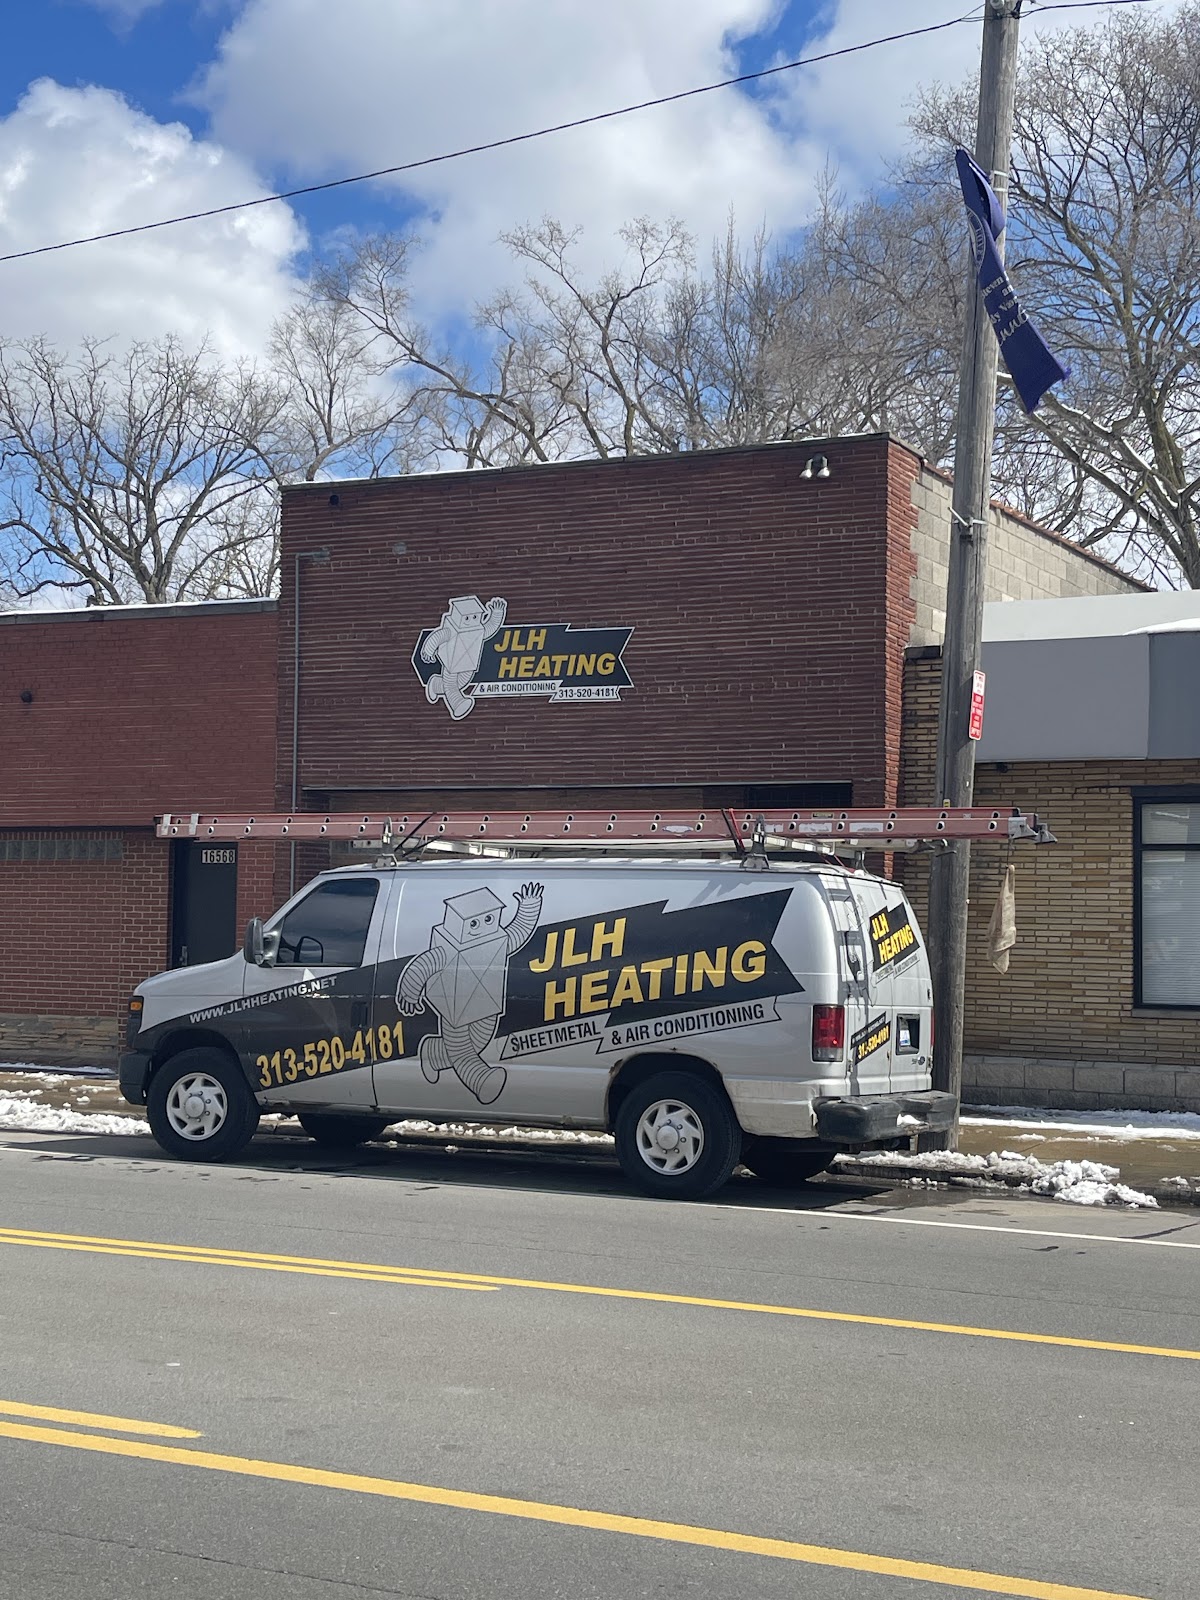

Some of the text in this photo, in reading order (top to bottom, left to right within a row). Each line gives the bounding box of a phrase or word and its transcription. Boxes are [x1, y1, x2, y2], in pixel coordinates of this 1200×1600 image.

[495, 629, 547, 652] JLH
[499, 653, 615, 678] HEATING
[479, 682, 556, 693] & AIR CONDITIONING
[558, 687, 615, 699] 313-520-4181
[204, 851, 233, 862] 16568
[872, 913, 890, 941] JLH
[878, 924, 914, 964] HEATING
[528, 917, 627, 974] JLH
[544, 940, 766, 1021] HEATING
[189, 975, 337, 1024] WWW.JLHHEATING.NET
[510, 1003, 765, 1052] SHEETMETAL & AIR CONDITIONING
[858, 1025, 889, 1060] 31-520-4181
[256, 1020, 405, 1088] 313-520-4181
